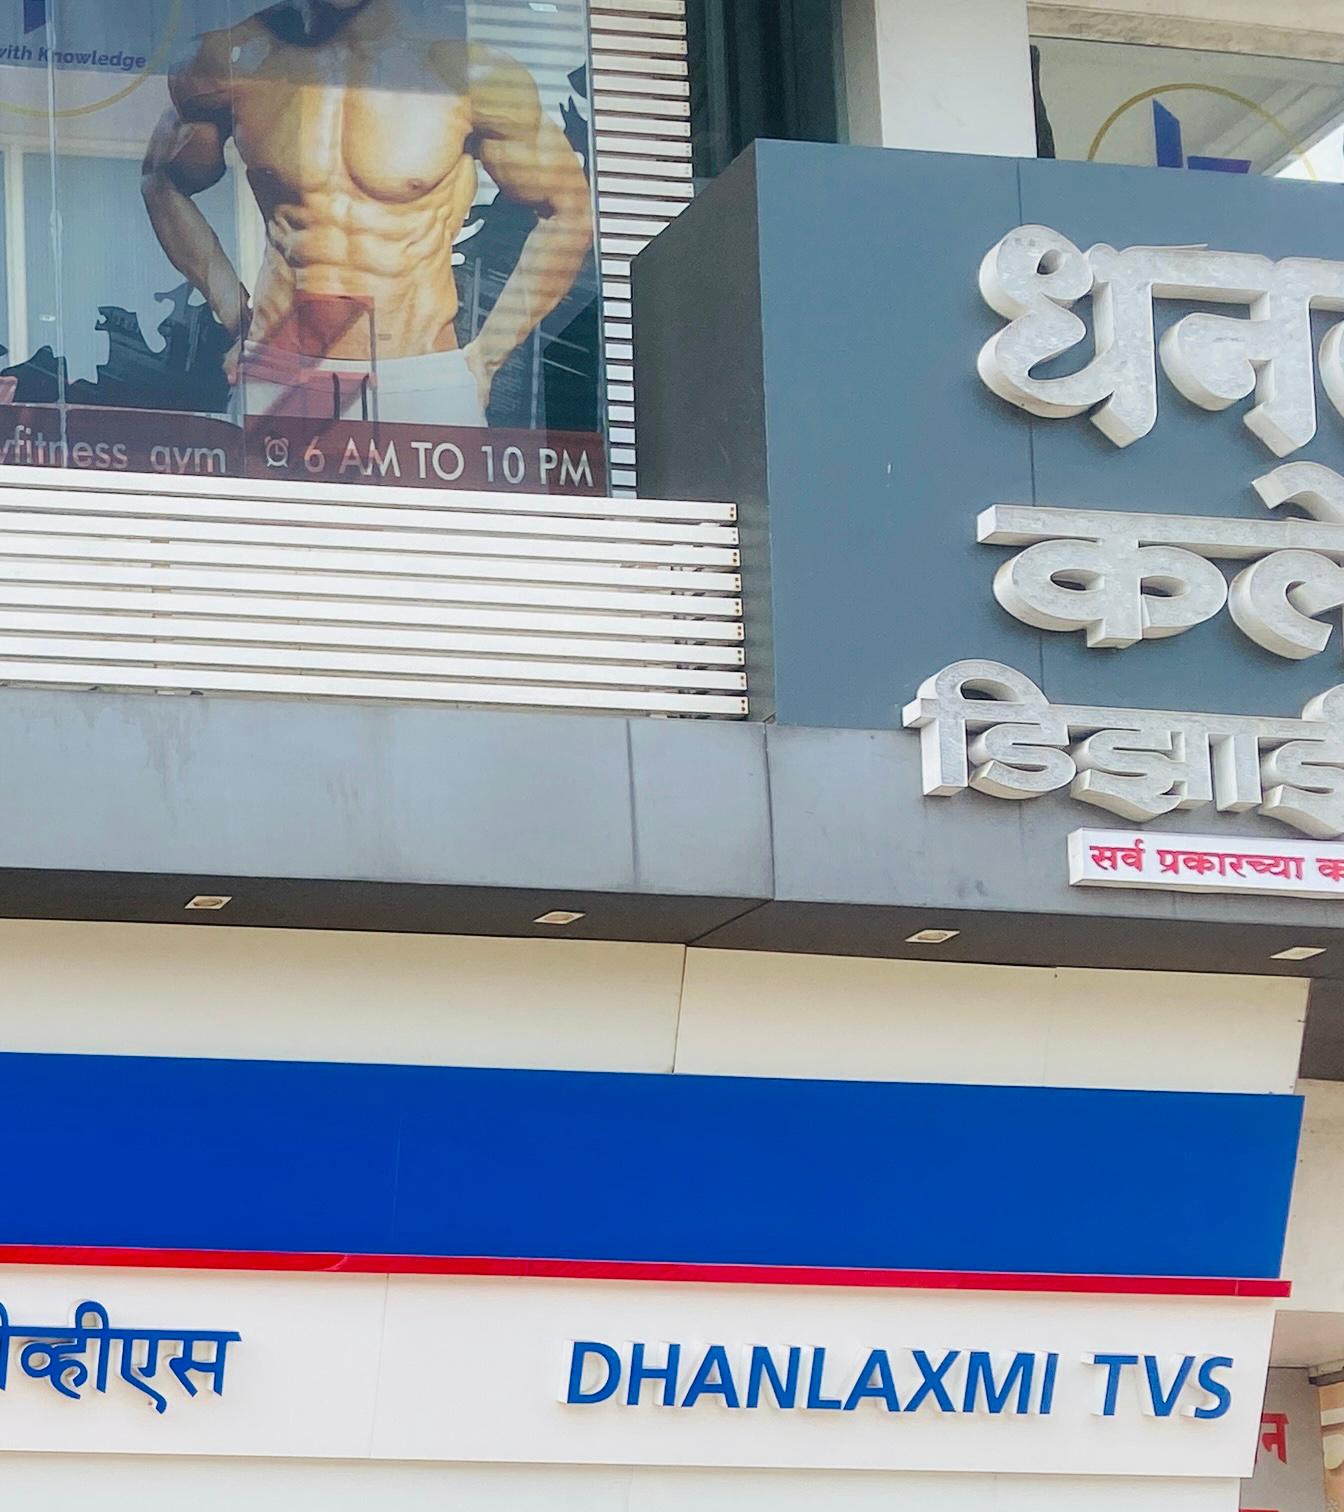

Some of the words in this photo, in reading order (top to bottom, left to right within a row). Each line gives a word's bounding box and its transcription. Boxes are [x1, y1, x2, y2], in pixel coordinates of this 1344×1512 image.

[38, 47, 147, 71] Knowledge
[304, 436, 325, 473] 6
[338, 437, 401, 477] AM
[412, 441, 464, 481] TO
[481, 446, 526, 484] 10
[538, 448, 594, 487] PM
[1089, 838, 1145, 872] सर्व
[1157, 849, 1305, 880] प्रकारच्या
[563, 1339, 1060, 1417] DHANLAXMI
[1084, 1352, 1235, 1420] TVS
